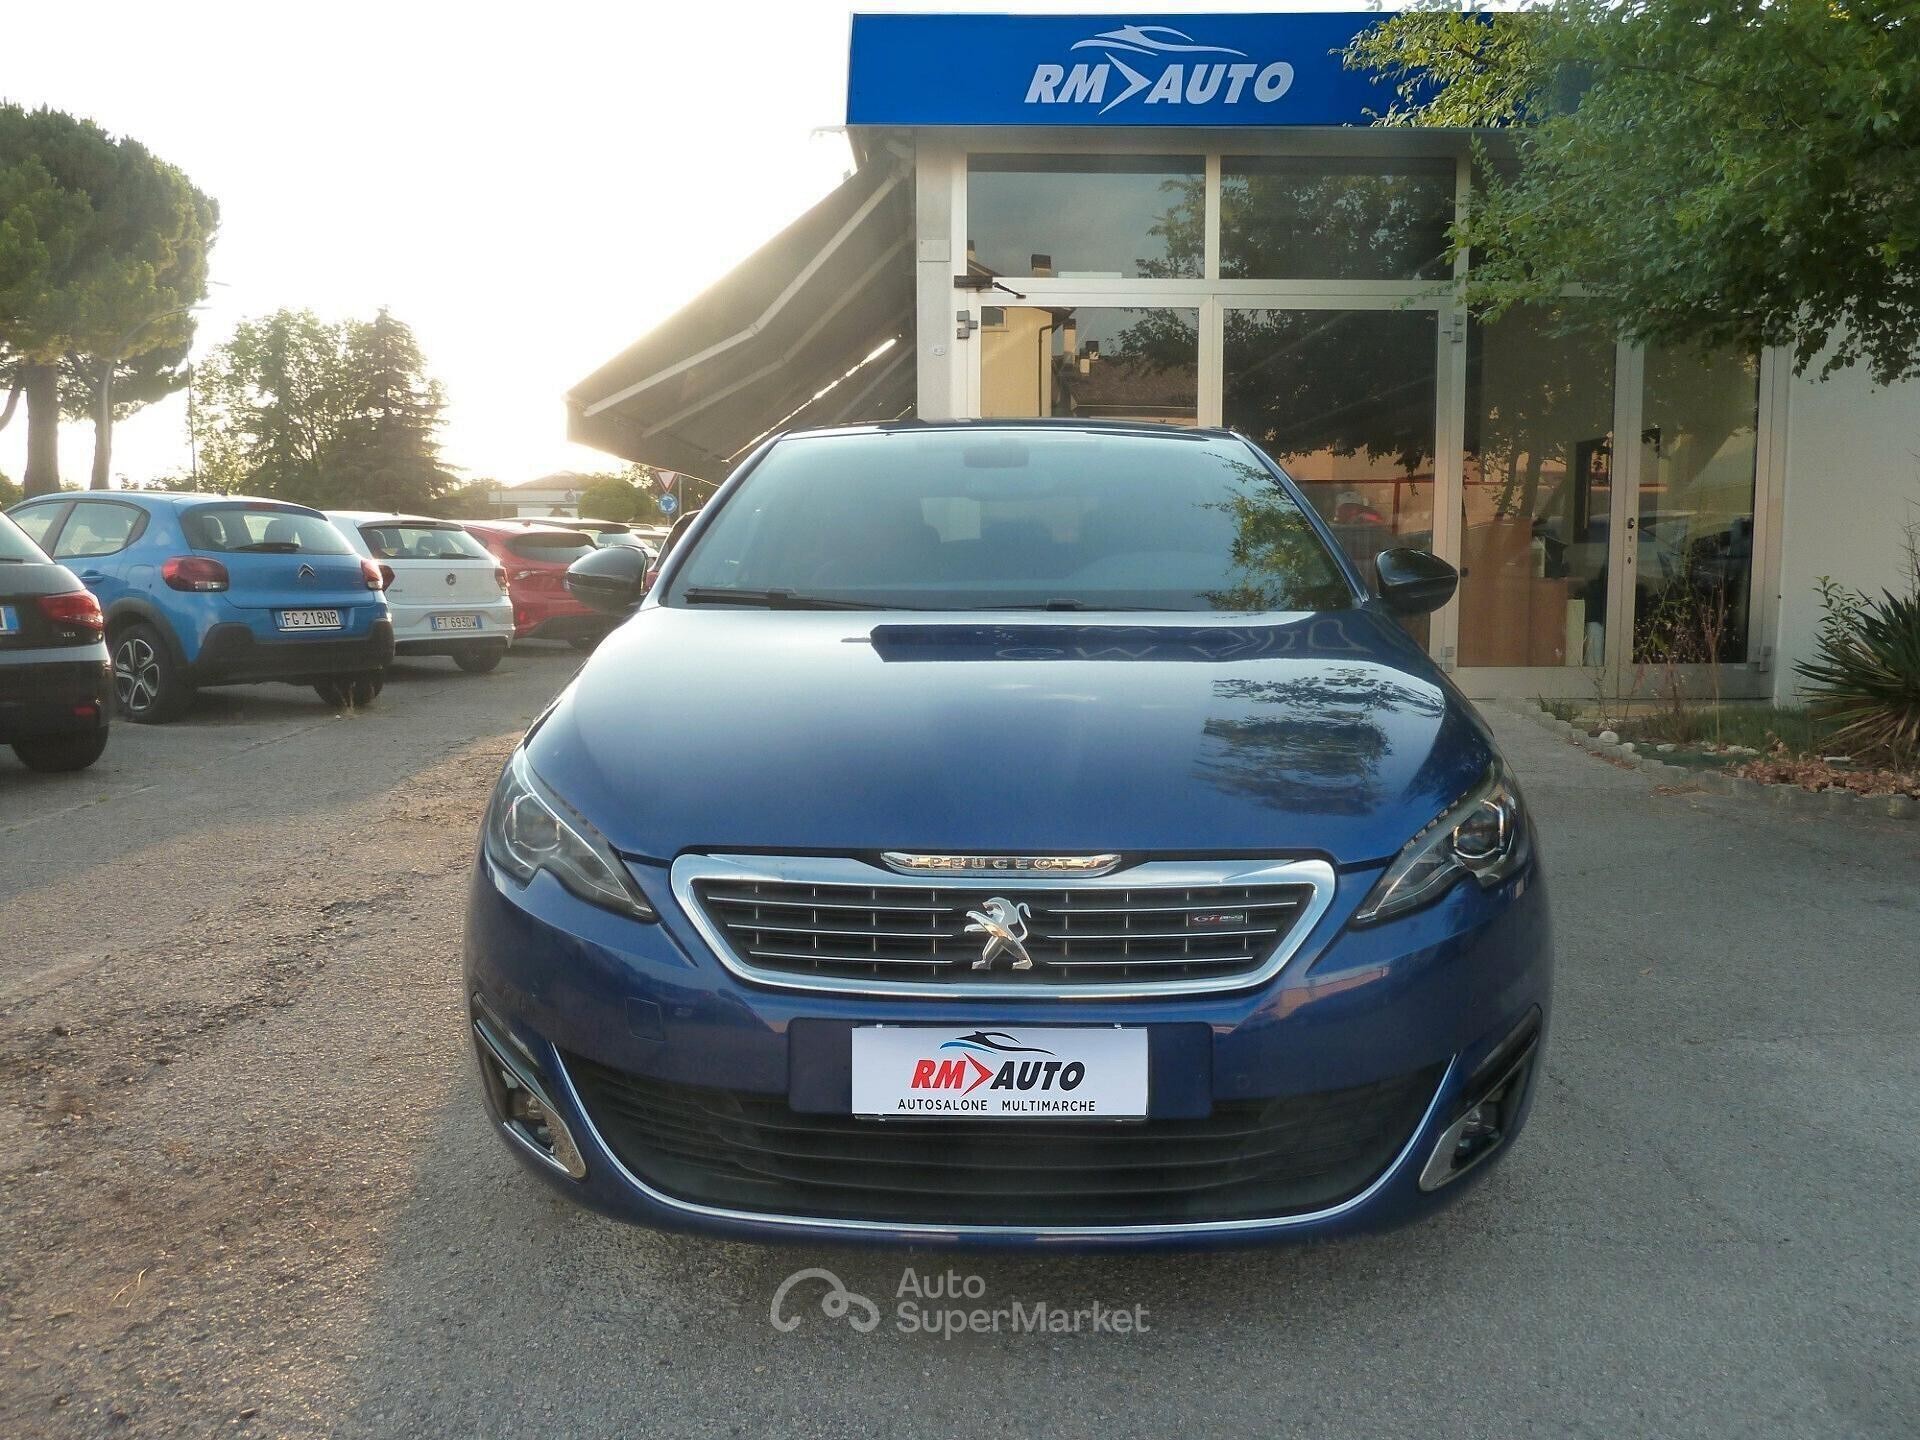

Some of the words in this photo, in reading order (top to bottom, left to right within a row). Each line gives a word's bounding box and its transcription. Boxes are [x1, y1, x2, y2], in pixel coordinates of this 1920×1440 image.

[1024, 64, 1110, 103] RM
[1144, 61, 1294, 104] AUTO
[283, 612, 299, 625] FG
[303, 611, 338, 625] 218NR
[929, 857, 1072, 869] PEUGEOT
[911, 1059, 966, 1089] RM
[990, 1061, 1085, 1091] AUTO
[898, 1099, 987, 1111] AUTOSALONE
[1002, 1101, 1095, 1112] MULTIMARCHE
